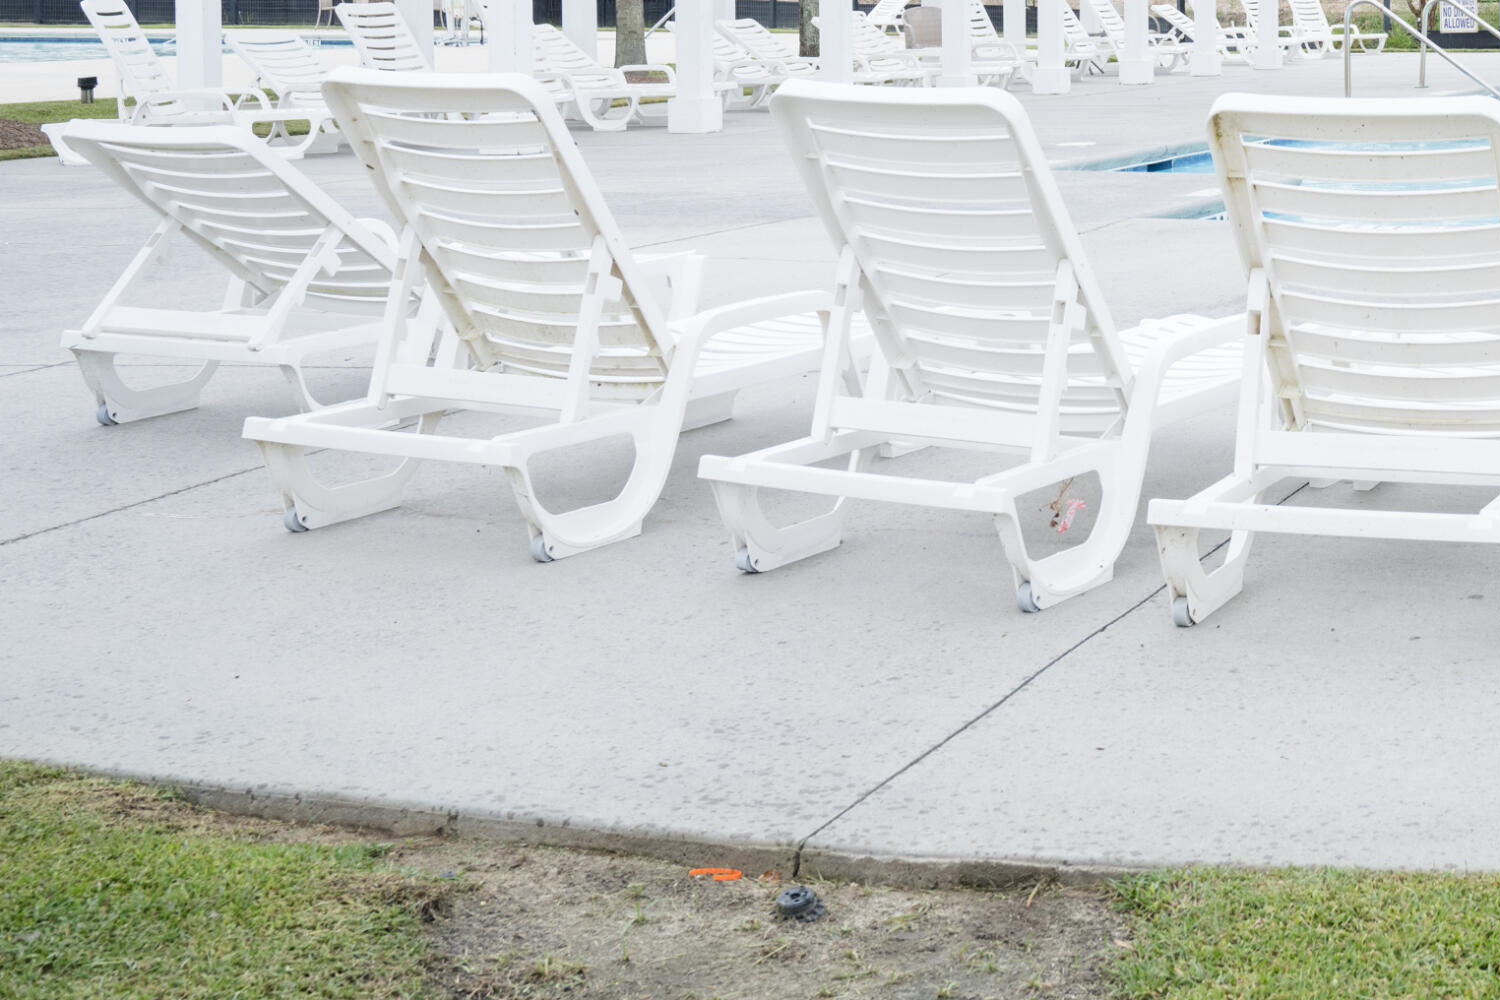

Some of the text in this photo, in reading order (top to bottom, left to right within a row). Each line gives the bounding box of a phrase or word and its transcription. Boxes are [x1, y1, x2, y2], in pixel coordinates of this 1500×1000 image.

[1443, 7, 1475, 17] NO DIVG
[1444, 18, 1475, 29] ALLOWED
